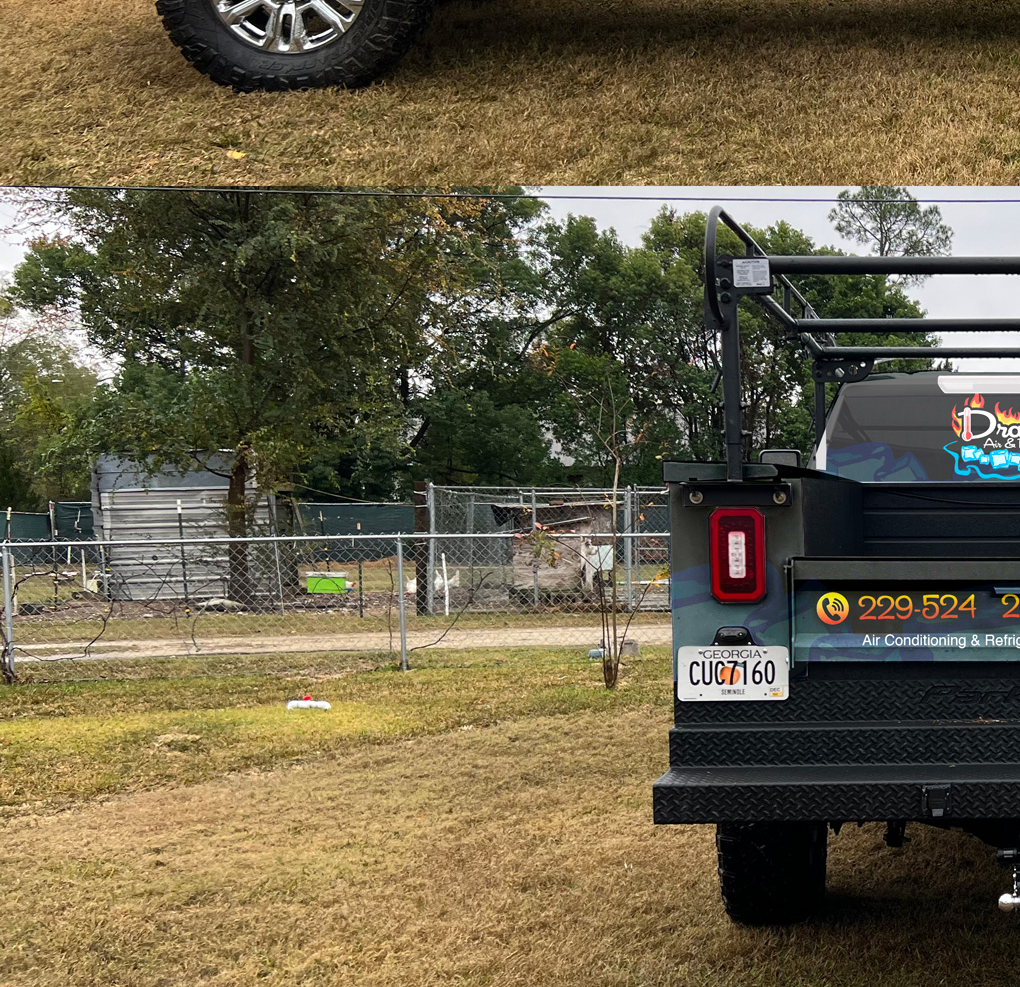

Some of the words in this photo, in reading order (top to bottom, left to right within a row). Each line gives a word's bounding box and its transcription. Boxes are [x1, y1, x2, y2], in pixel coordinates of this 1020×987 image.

[982, 437, 1002, 449] Air
[1004, 437, 1017, 449] &
[858, 594, 977, 620] 229-524
[861, 633, 881, 647] Air
[884, 633, 967, 649] Conditioning
[970, 633, 981, 647] &
[702, 649, 763, 660] GEORGIA
[688, 659, 776, 686] CUC7160
[720, 688, 746, 696] SEMINOLE
